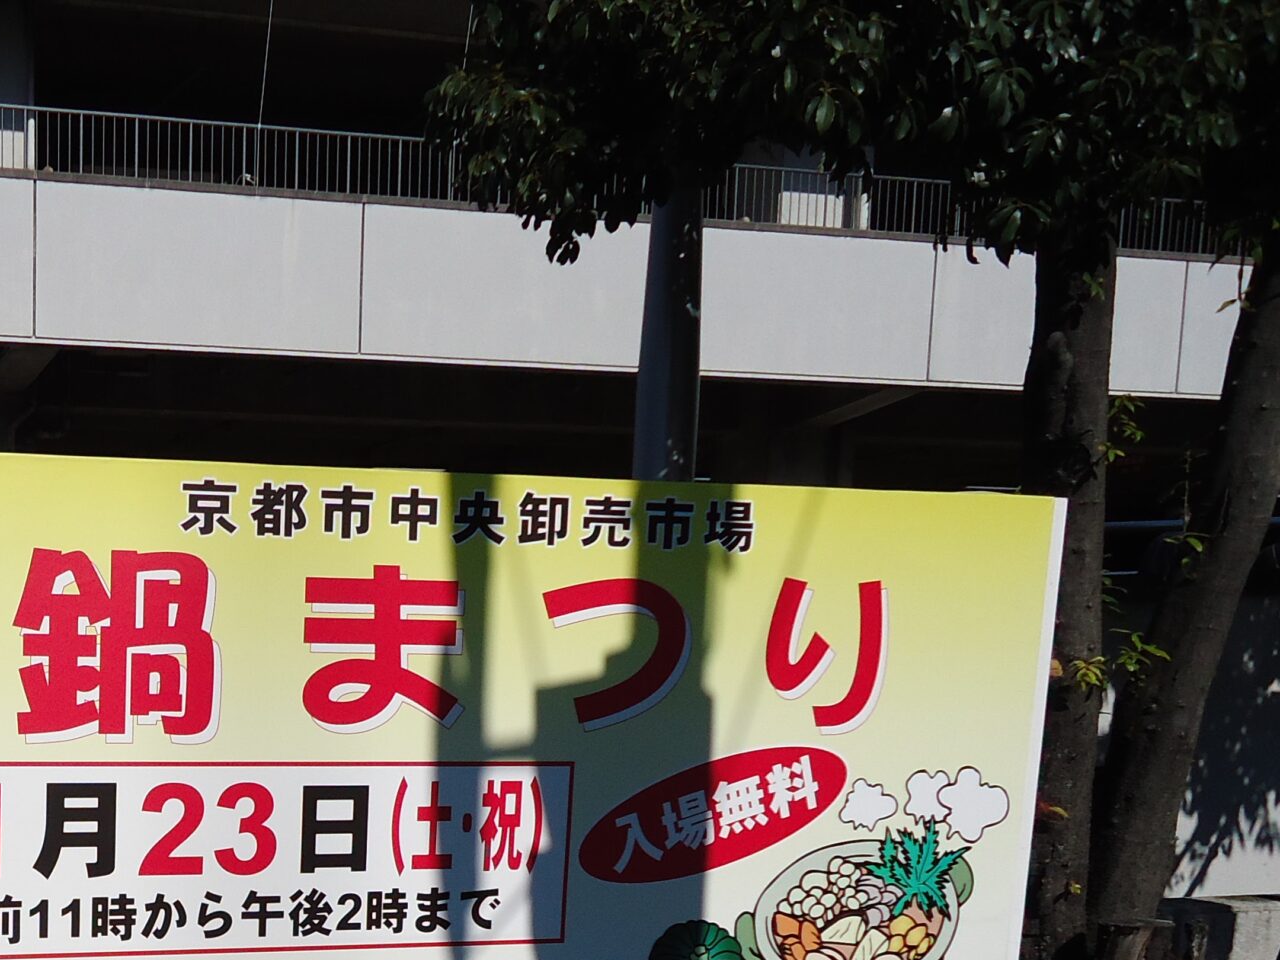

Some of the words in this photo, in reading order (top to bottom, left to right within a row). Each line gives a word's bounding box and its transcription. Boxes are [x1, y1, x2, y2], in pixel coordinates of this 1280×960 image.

[179, 480, 757, 554] 京都市中央卸売市場
[13, 547, 888, 744] 鍋まつり
[613, 755, 819, 874] 入場無料
